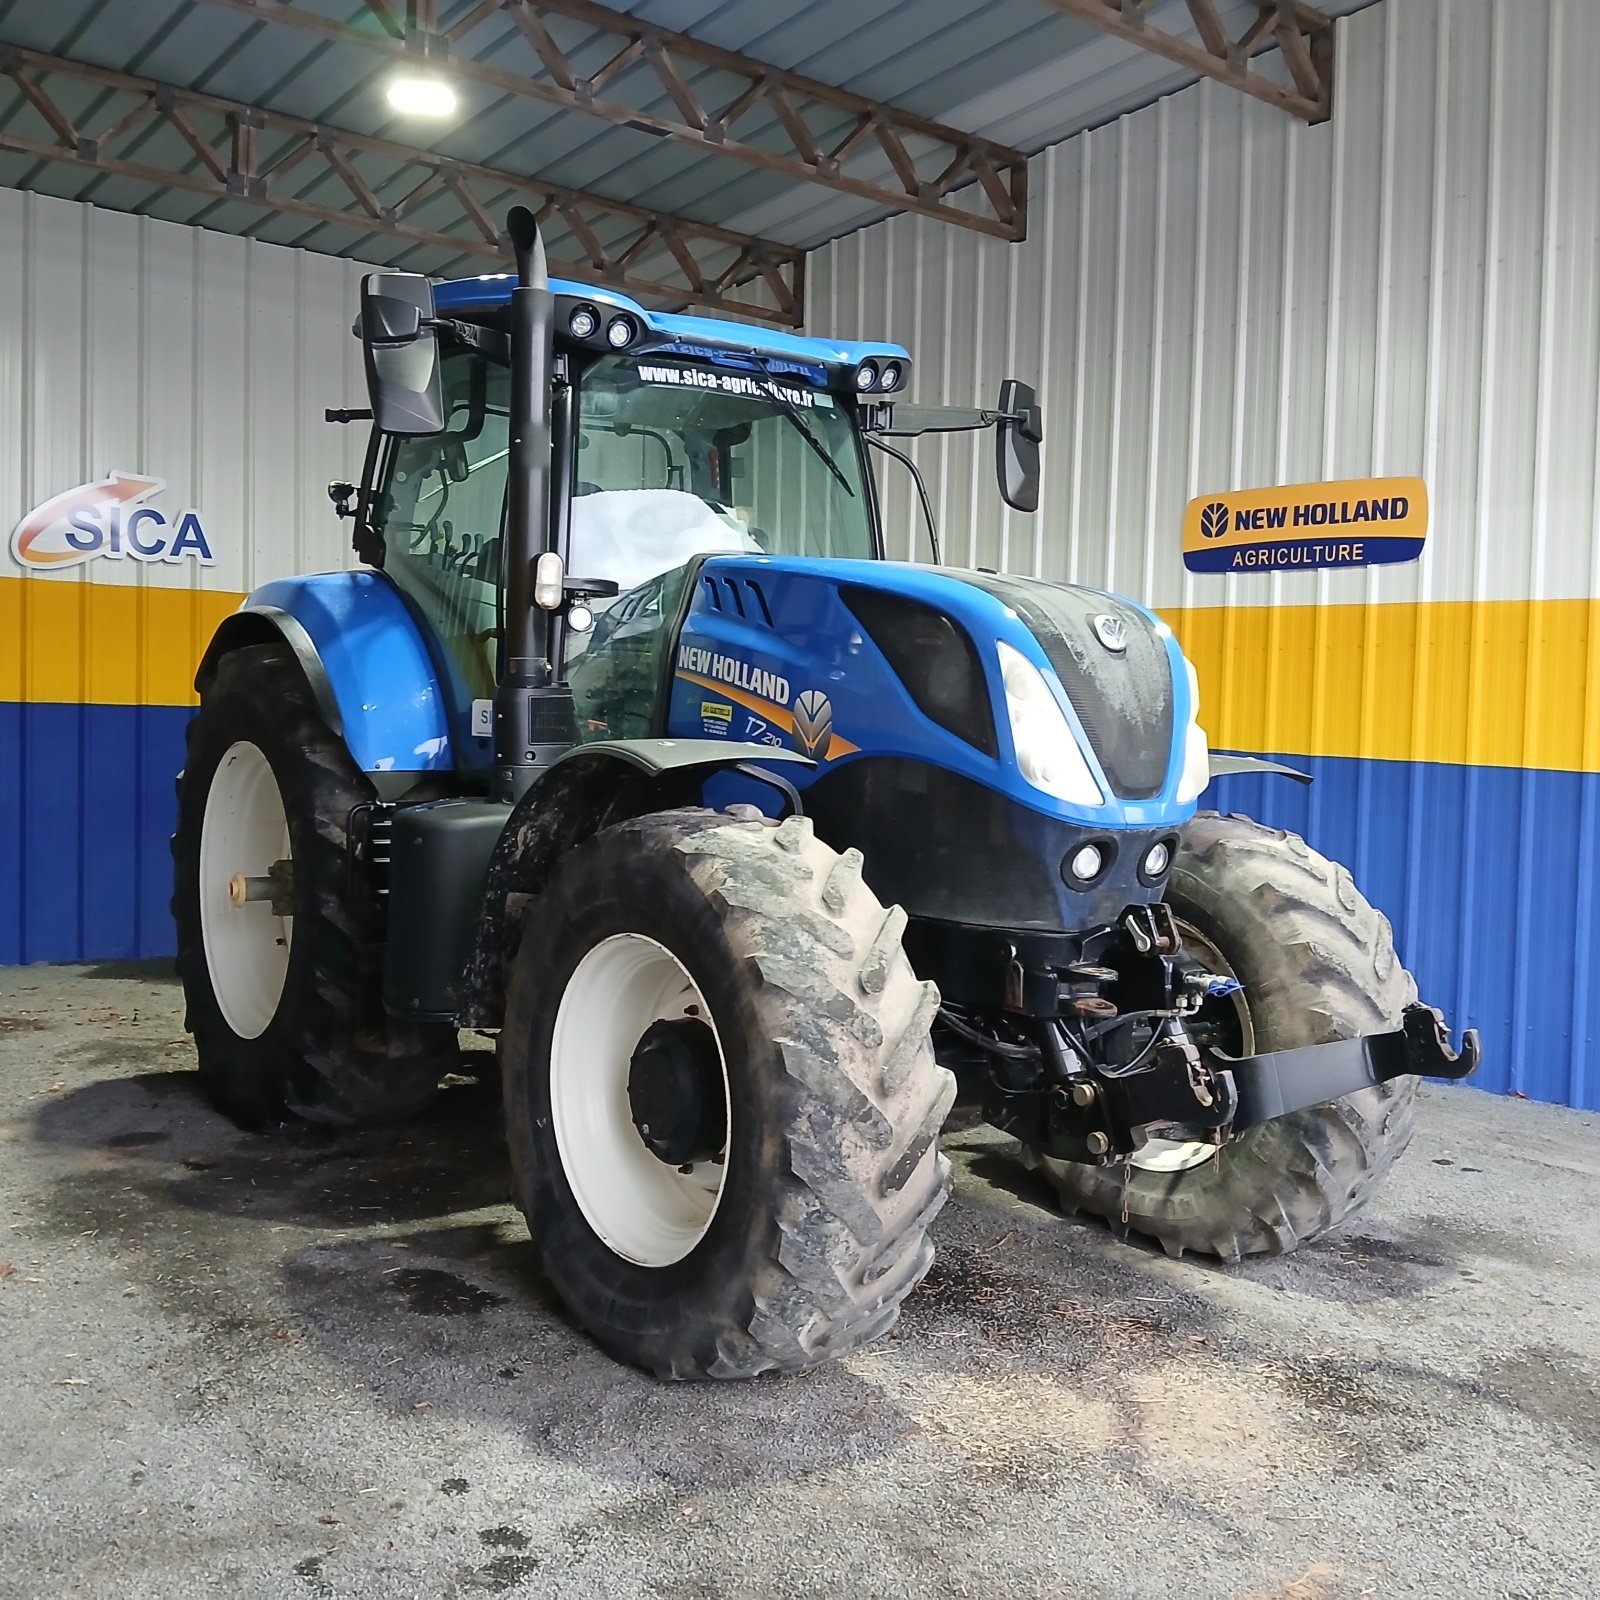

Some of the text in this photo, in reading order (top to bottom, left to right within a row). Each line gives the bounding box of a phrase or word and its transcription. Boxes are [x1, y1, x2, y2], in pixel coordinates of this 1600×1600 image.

[65, 504, 213, 559] SICA
[1234, 496, 1409, 531] NEW HOLLAND
[1232, 543, 1364, 567] AGRICULTURE
[678, 645, 790, 705] NEW HOLLAND
